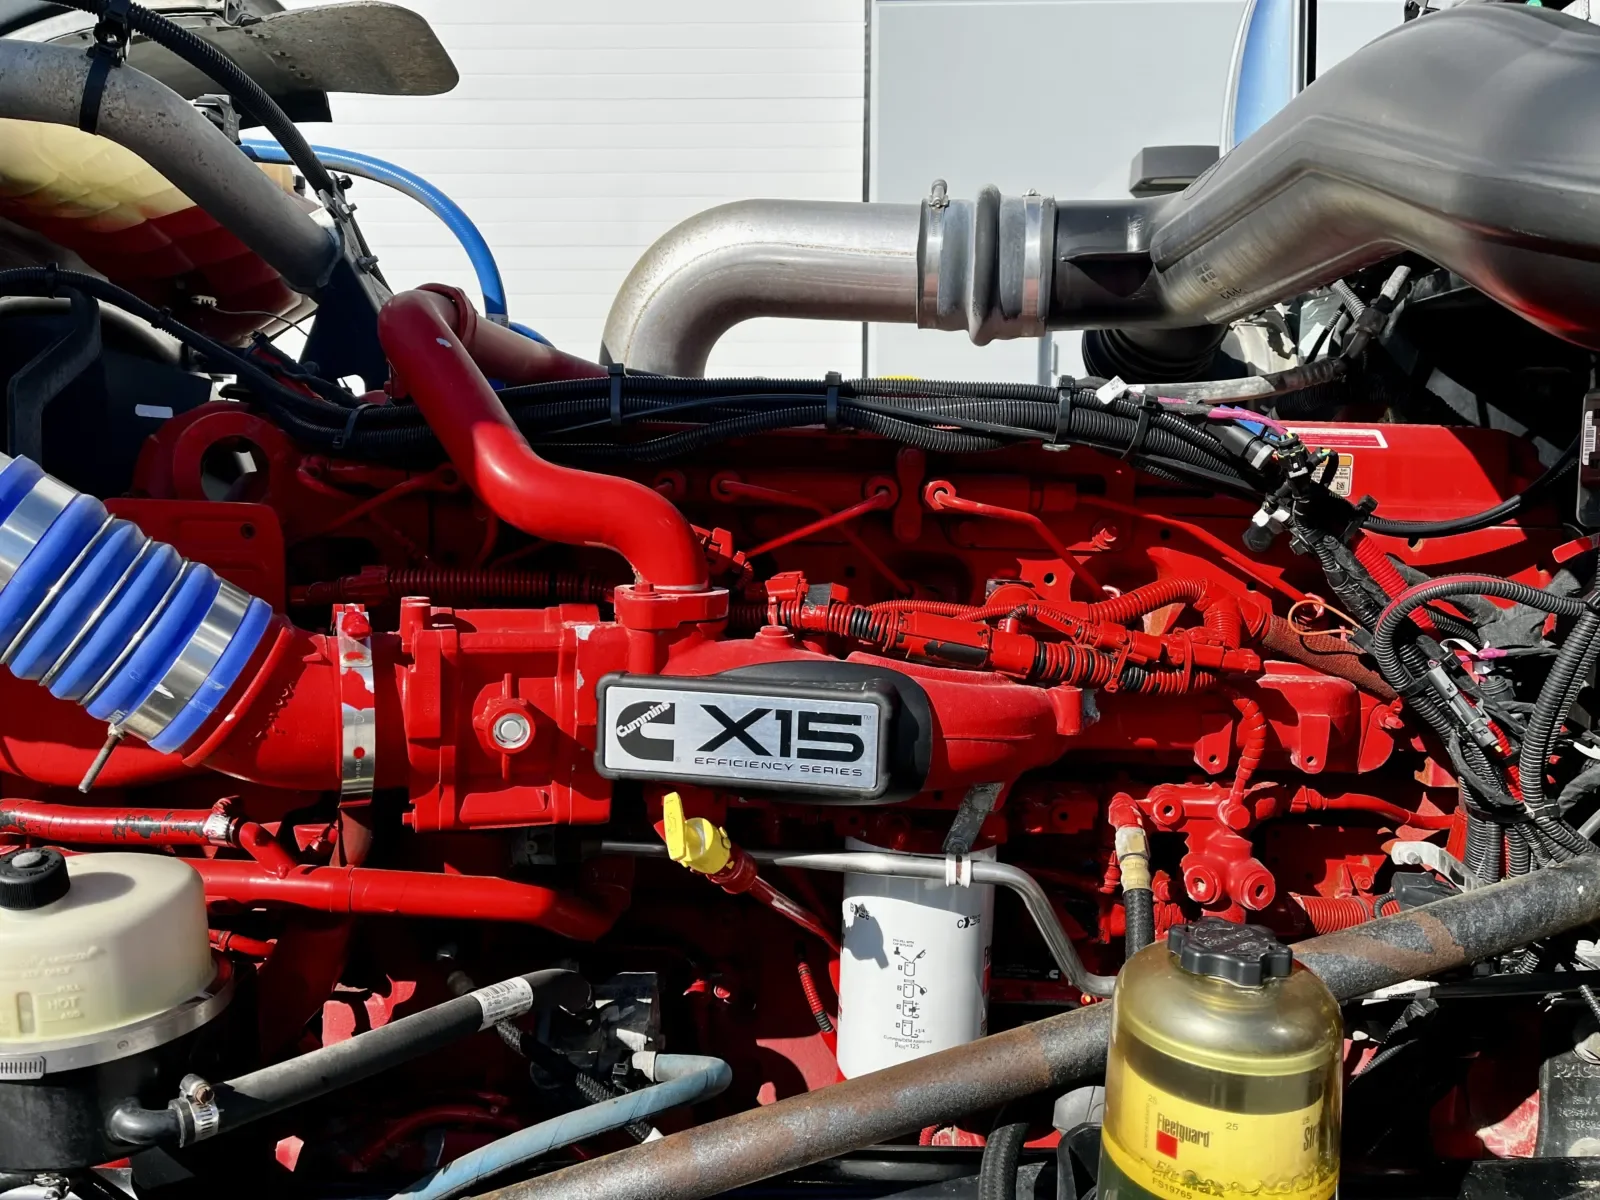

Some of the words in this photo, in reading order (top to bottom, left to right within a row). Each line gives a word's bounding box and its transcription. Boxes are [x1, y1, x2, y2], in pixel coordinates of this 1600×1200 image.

[616, 701, 671, 739] Cummins
[696, 704, 865, 763] X15
[694, 757, 794, 772] EFFICIENCY
[799, 764, 863, 777] SERIES
[47, 996, 79, 1010] HOT
[1157, 1112, 1210, 1148] Fleetguard
[1225, 1121, 1239, 1131] 25
[1152, 1177, 1193, 1200] FS19765
